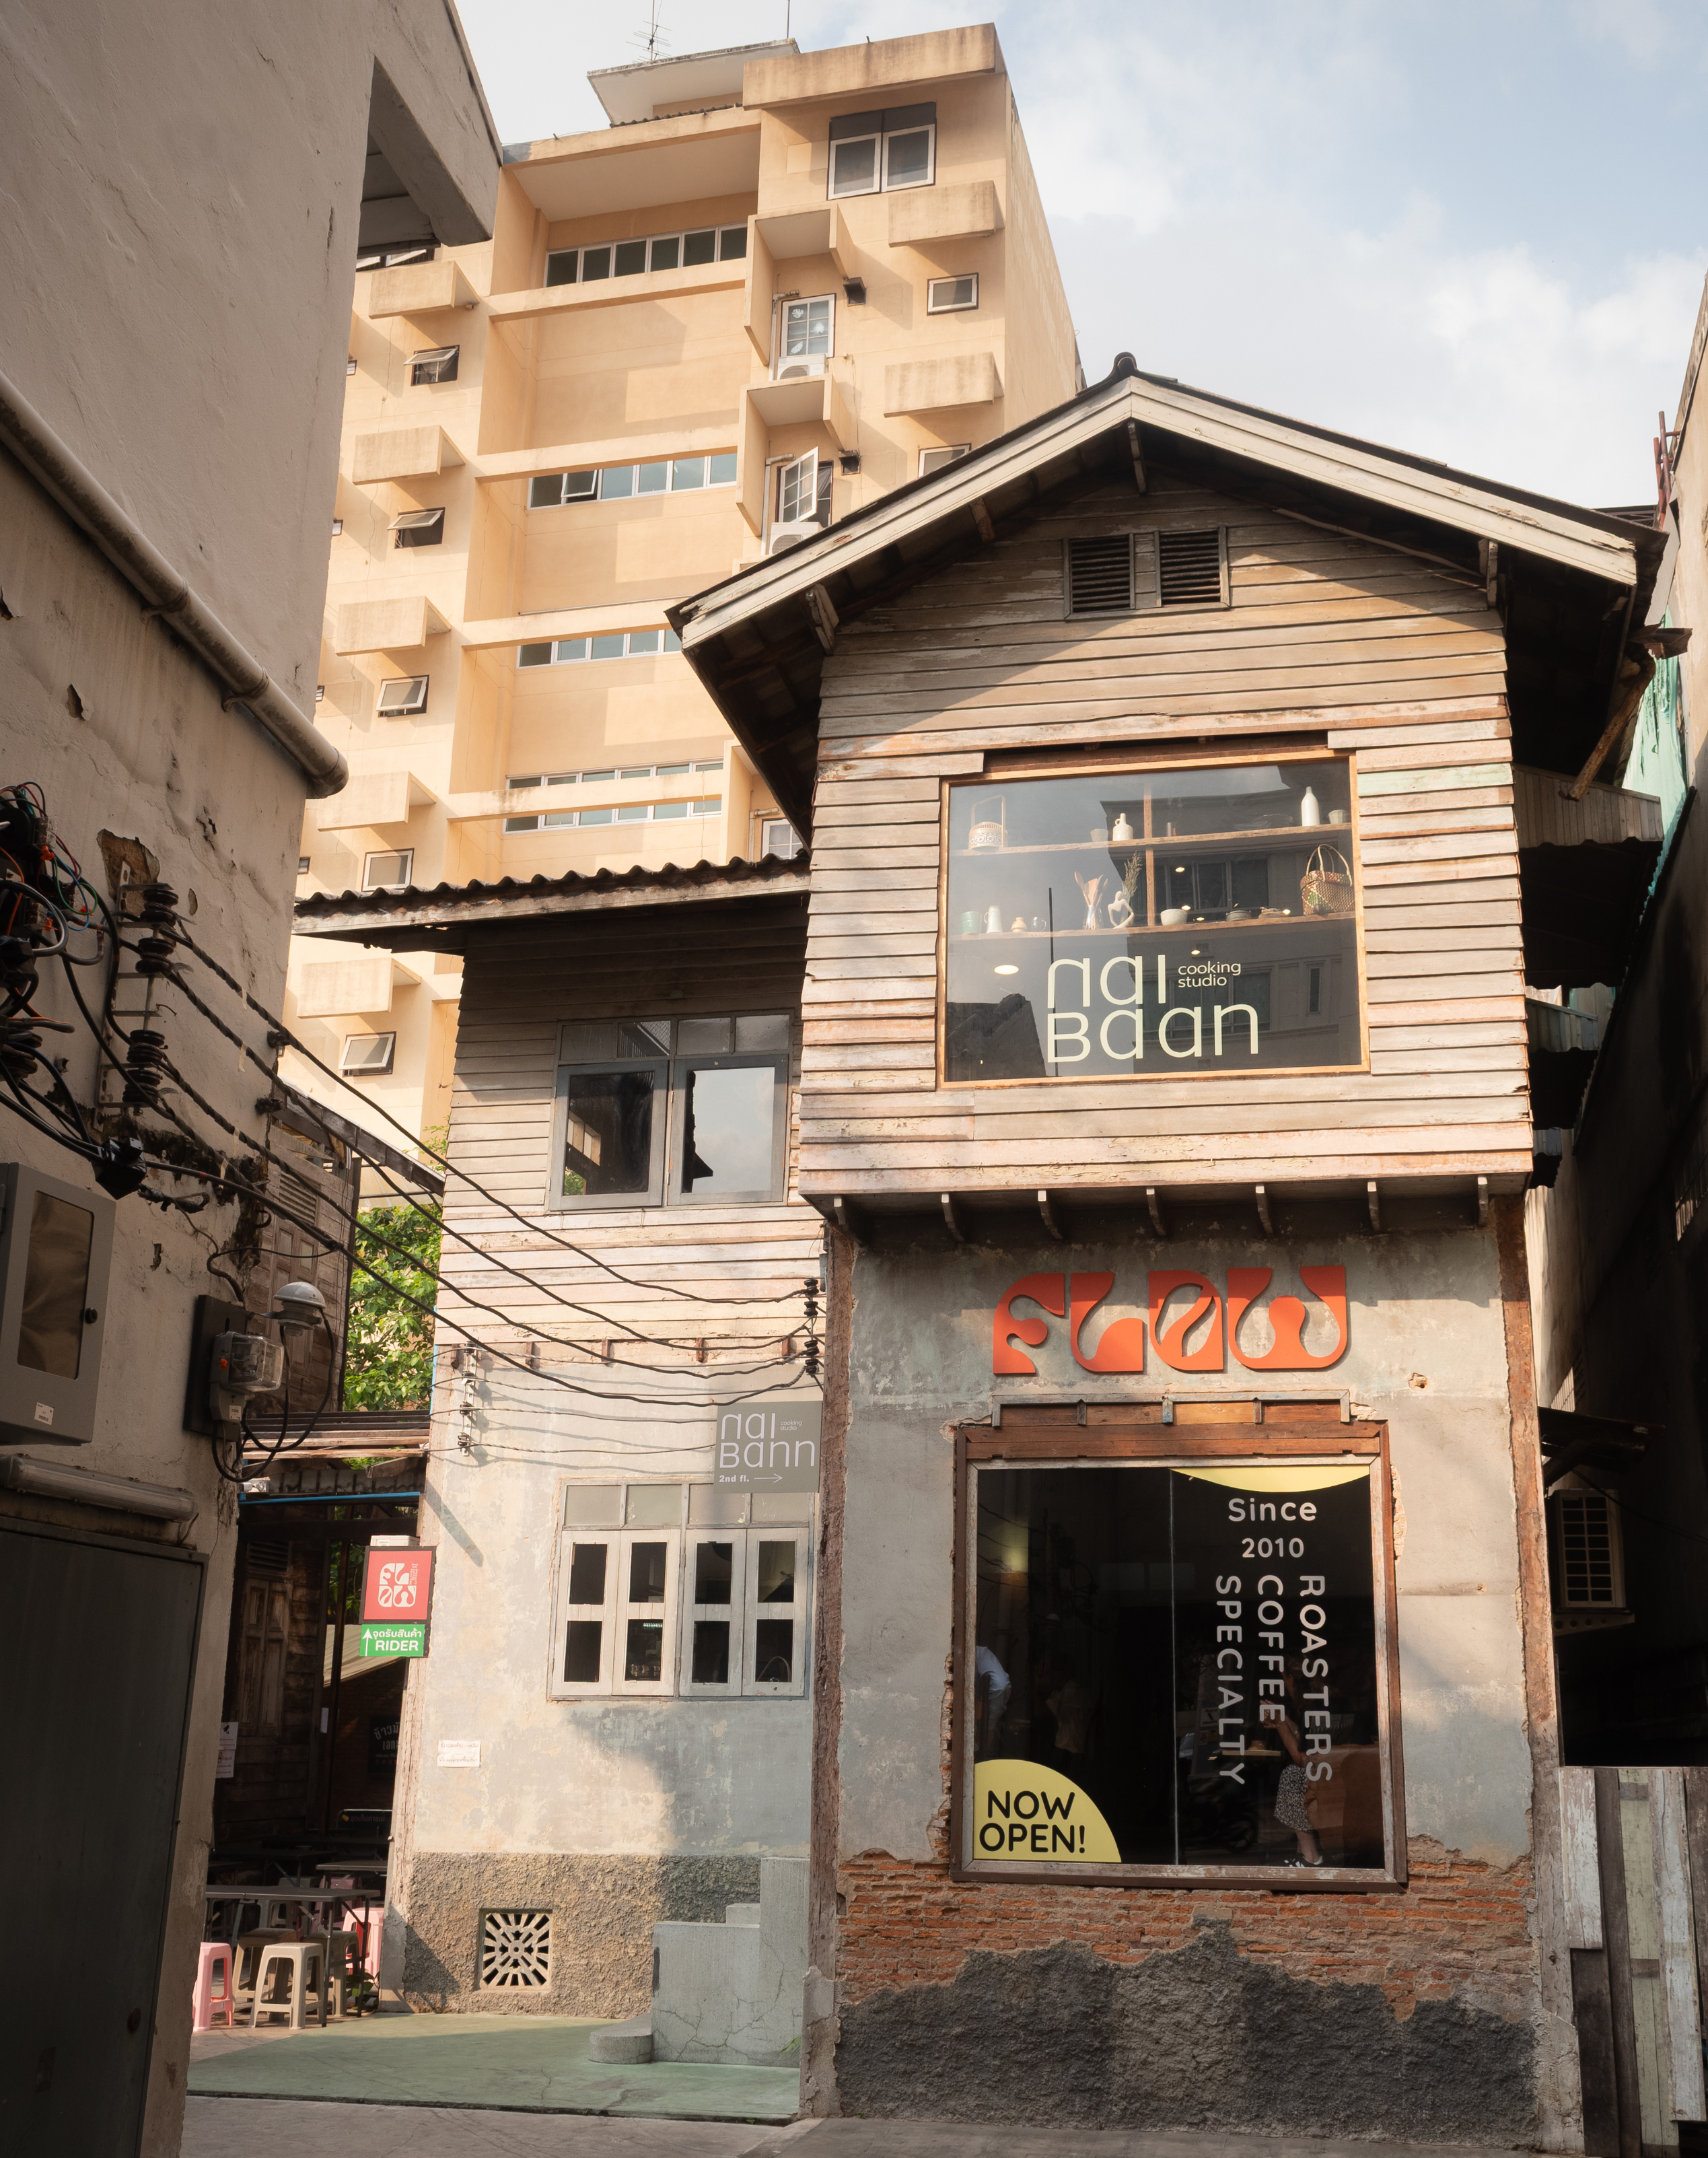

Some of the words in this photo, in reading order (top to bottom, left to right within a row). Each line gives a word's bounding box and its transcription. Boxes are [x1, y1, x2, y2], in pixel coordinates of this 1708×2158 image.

[1178, 961, 1241, 977] cooking
[1178, 973, 1227, 987] studio
[1047, 1004, 1258, 1063] Baan
[993, 1265, 1348, 1374] FLOW
[719, 1475, 737, 1483] 2nd
[1228, 1498, 1317, 1522] Since
[1242, 1537, 1304, 1558] 2010
[373, 1628, 422, 1640] จุดรับสินค้า
[375, 1640, 419, 1651] RIDER
[1257, 1574, 1285, 1722] COFFEE
[1215, 1575, 1245, 1785] SPECIALTY
[1300, 1575, 1332, 1782] ROASTERS
[988, 1790, 1075, 1819] NOW
[979, 1823, 1085, 1854] OPEN!
